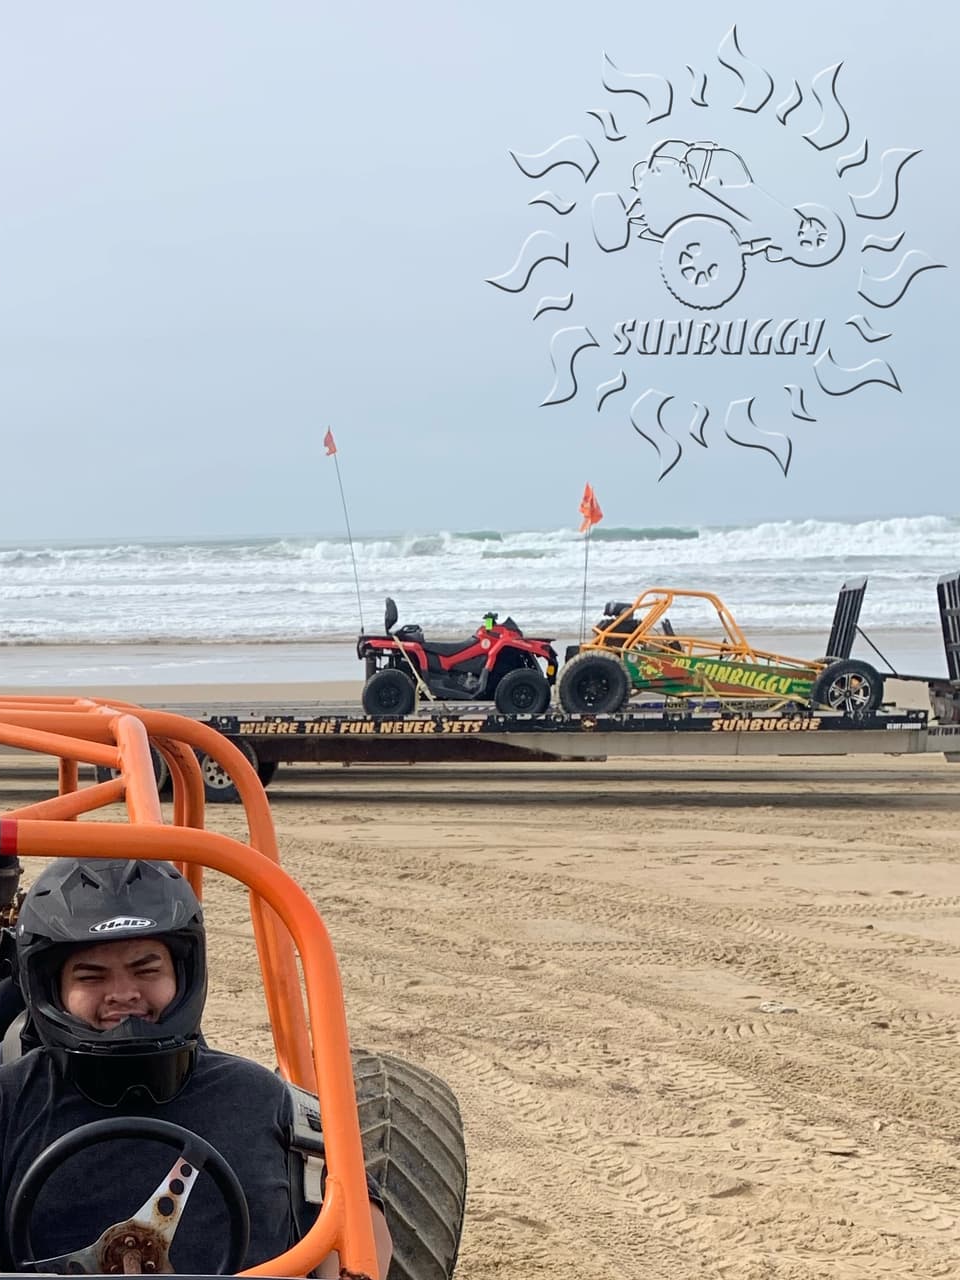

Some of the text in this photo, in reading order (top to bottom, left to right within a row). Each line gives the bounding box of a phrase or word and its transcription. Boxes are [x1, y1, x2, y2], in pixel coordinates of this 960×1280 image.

[240, 720, 483, 734] WHERE THE FUN NEVER SETS
[711, 717, 821, 732] SUNBUGGIE
